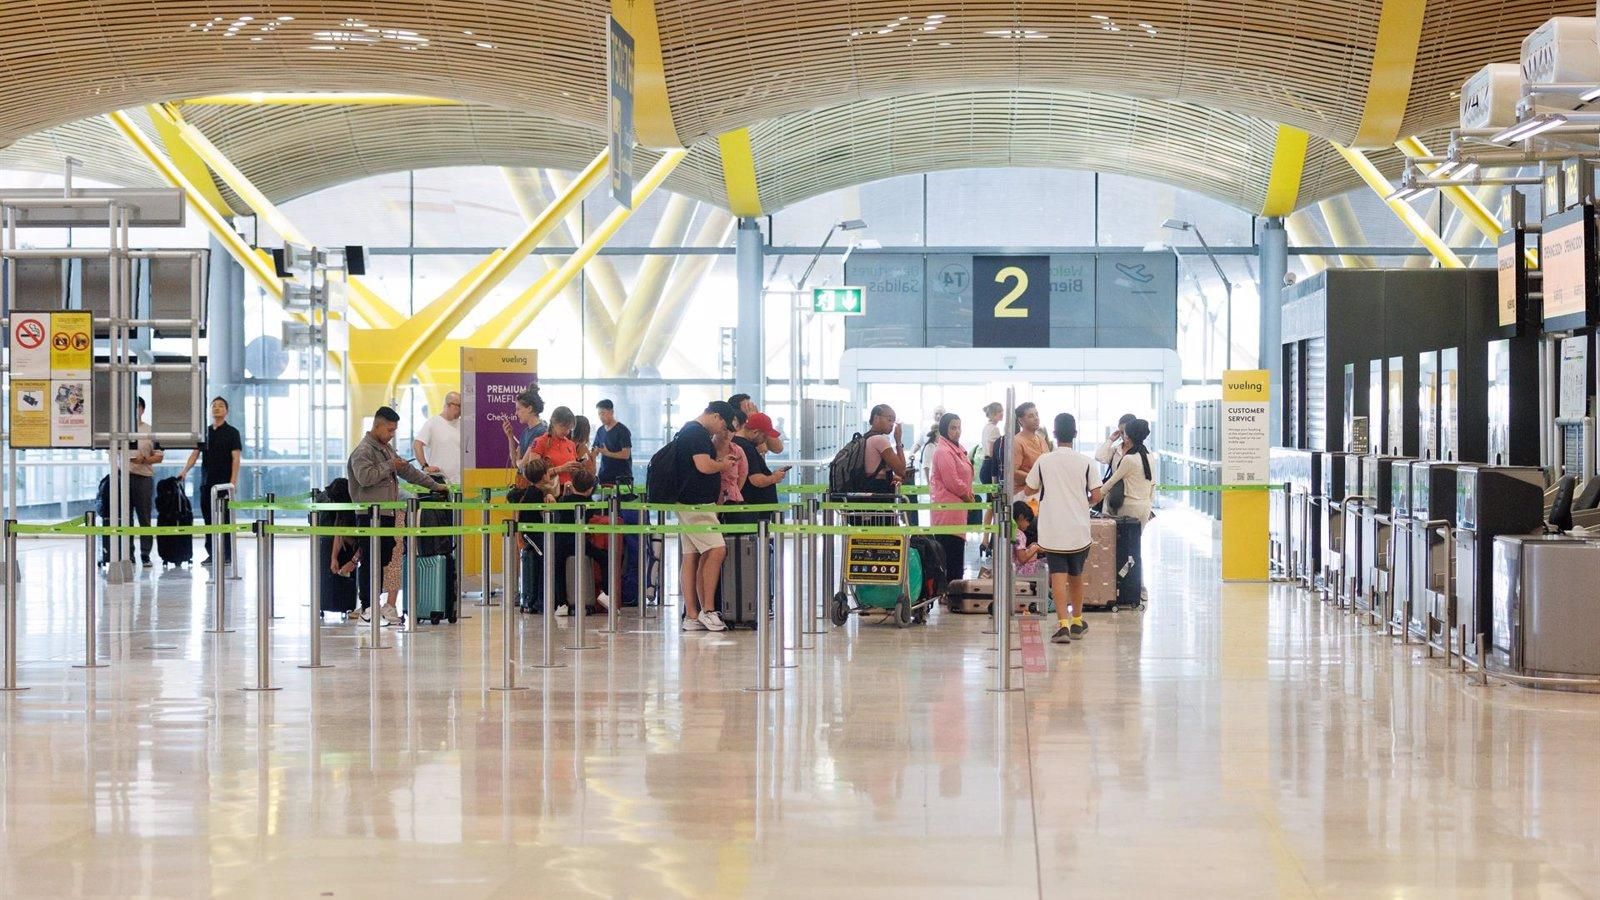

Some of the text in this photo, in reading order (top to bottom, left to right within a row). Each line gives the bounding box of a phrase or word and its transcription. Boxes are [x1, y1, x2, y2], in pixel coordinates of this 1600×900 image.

[994, 266, 1028, 317] 2
[501, 355, 528, 366] vueling
[487, 385, 527, 394] PREMIUM
[1228, 381, 1262, 393] vueling
[487, 394, 518, 403] TIMEFL
[487, 412, 518, 421] Check-in
